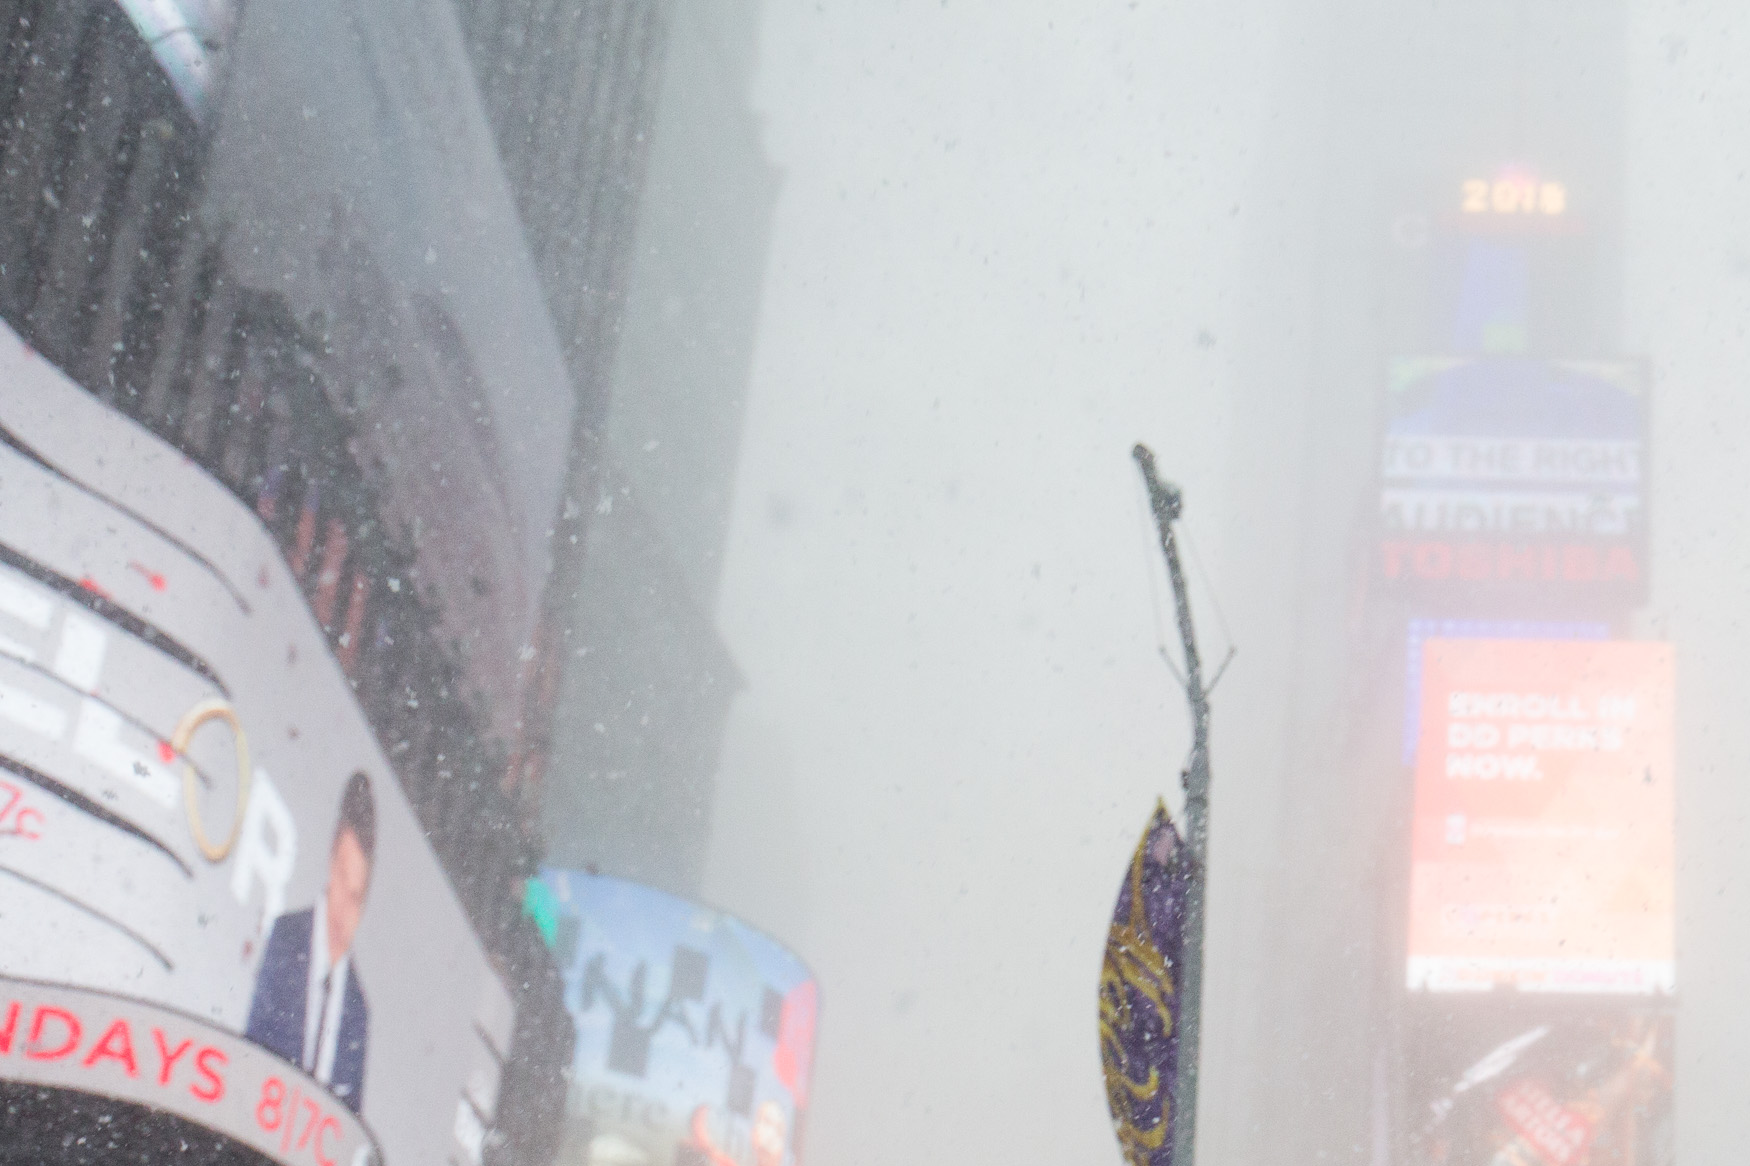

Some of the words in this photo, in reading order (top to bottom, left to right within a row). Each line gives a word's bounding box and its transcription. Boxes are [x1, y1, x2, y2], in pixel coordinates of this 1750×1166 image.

[1380, 539, 1640, 583] TOSHIBA
[1447, 690, 1588, 719] ENROLL
[1507, 723, 1623, 753] PERKS
